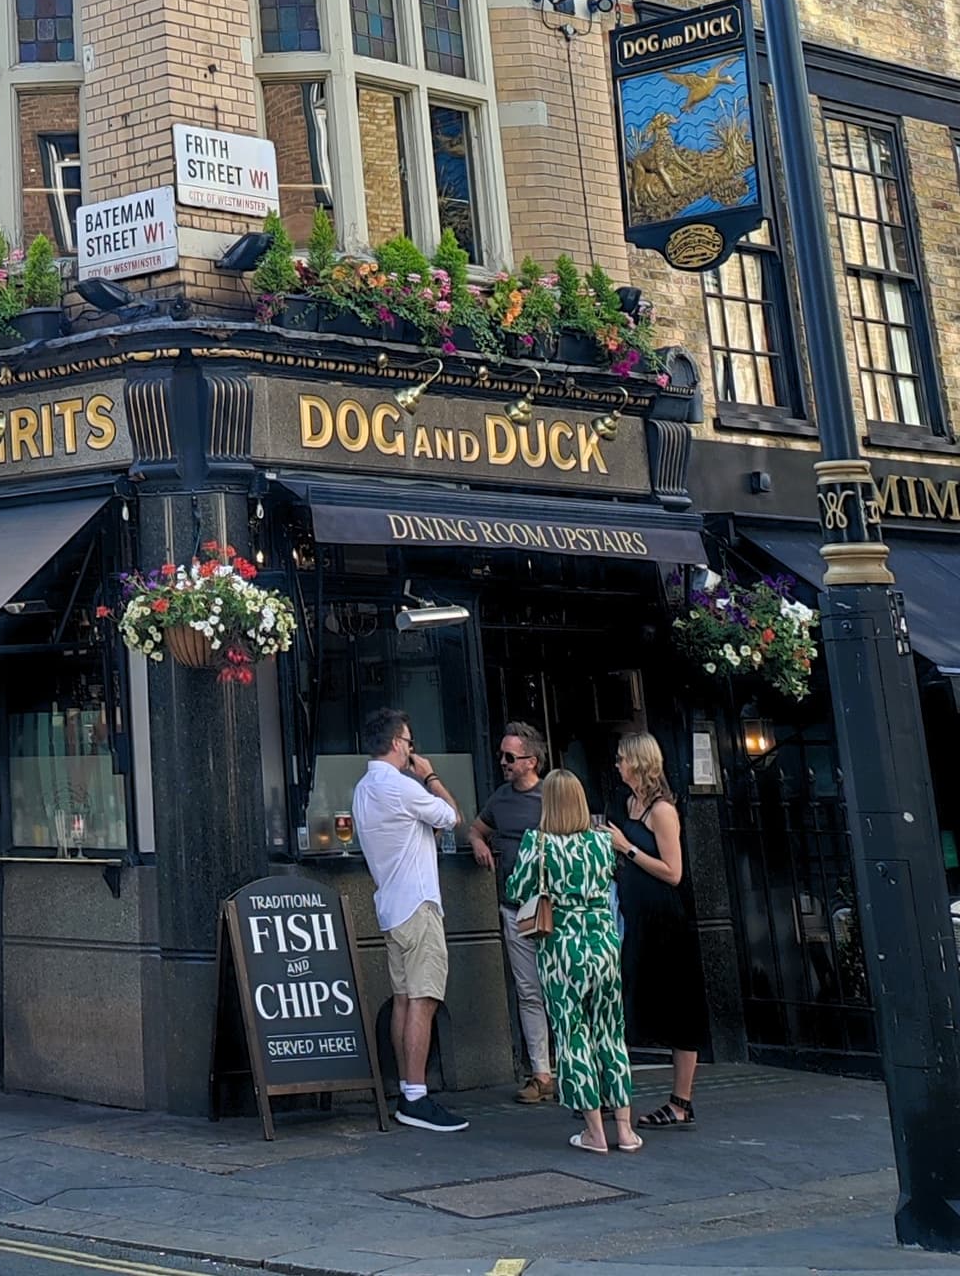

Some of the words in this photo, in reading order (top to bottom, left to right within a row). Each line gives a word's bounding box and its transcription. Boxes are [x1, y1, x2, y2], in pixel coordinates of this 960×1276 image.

[623, 34, 659, 59] DOG
[661, 35, 683, 50] AND
[684, 14, 734, 43] DUCK
[185, 134, 229, 160] FRITH
[187, 158, 243, 186] STREET
[248, 169, 270, 191] W1
[85, 197, 155, 233] BATEMAN
[189, 190, 204, 202] CITY
[206, 193, 215, 203] OF
[217, 195, 266, 212] WESTMINSTER
[86, 228, 137, 258] STREET
[143, 222, 165, 245] W1
[87, 266, 103, 277] CITY
[103, 264, 113, 275] OF
[113, 255, 162, 273] WESTMINSTER
[298, 393, 405, 457] DOG
[413, 426, 480, 462] AND
[484, 413, 609, 474] DUCK
[387, 514, 478, 542] DINING
[477, 520, 549, 548] ROOM
[547, 526, 648, 556] UPSTAIRS
[249, 893, 326, 909] TRADITIONAL
[247, 912, 339, 954] FISH
[286, 958, 310, 974] AND
[254, 980, 355, 1020] CHIPS
[267, 1038, 314, 1056] SERVED
[318, 1036, 357, 1053] HERE!
